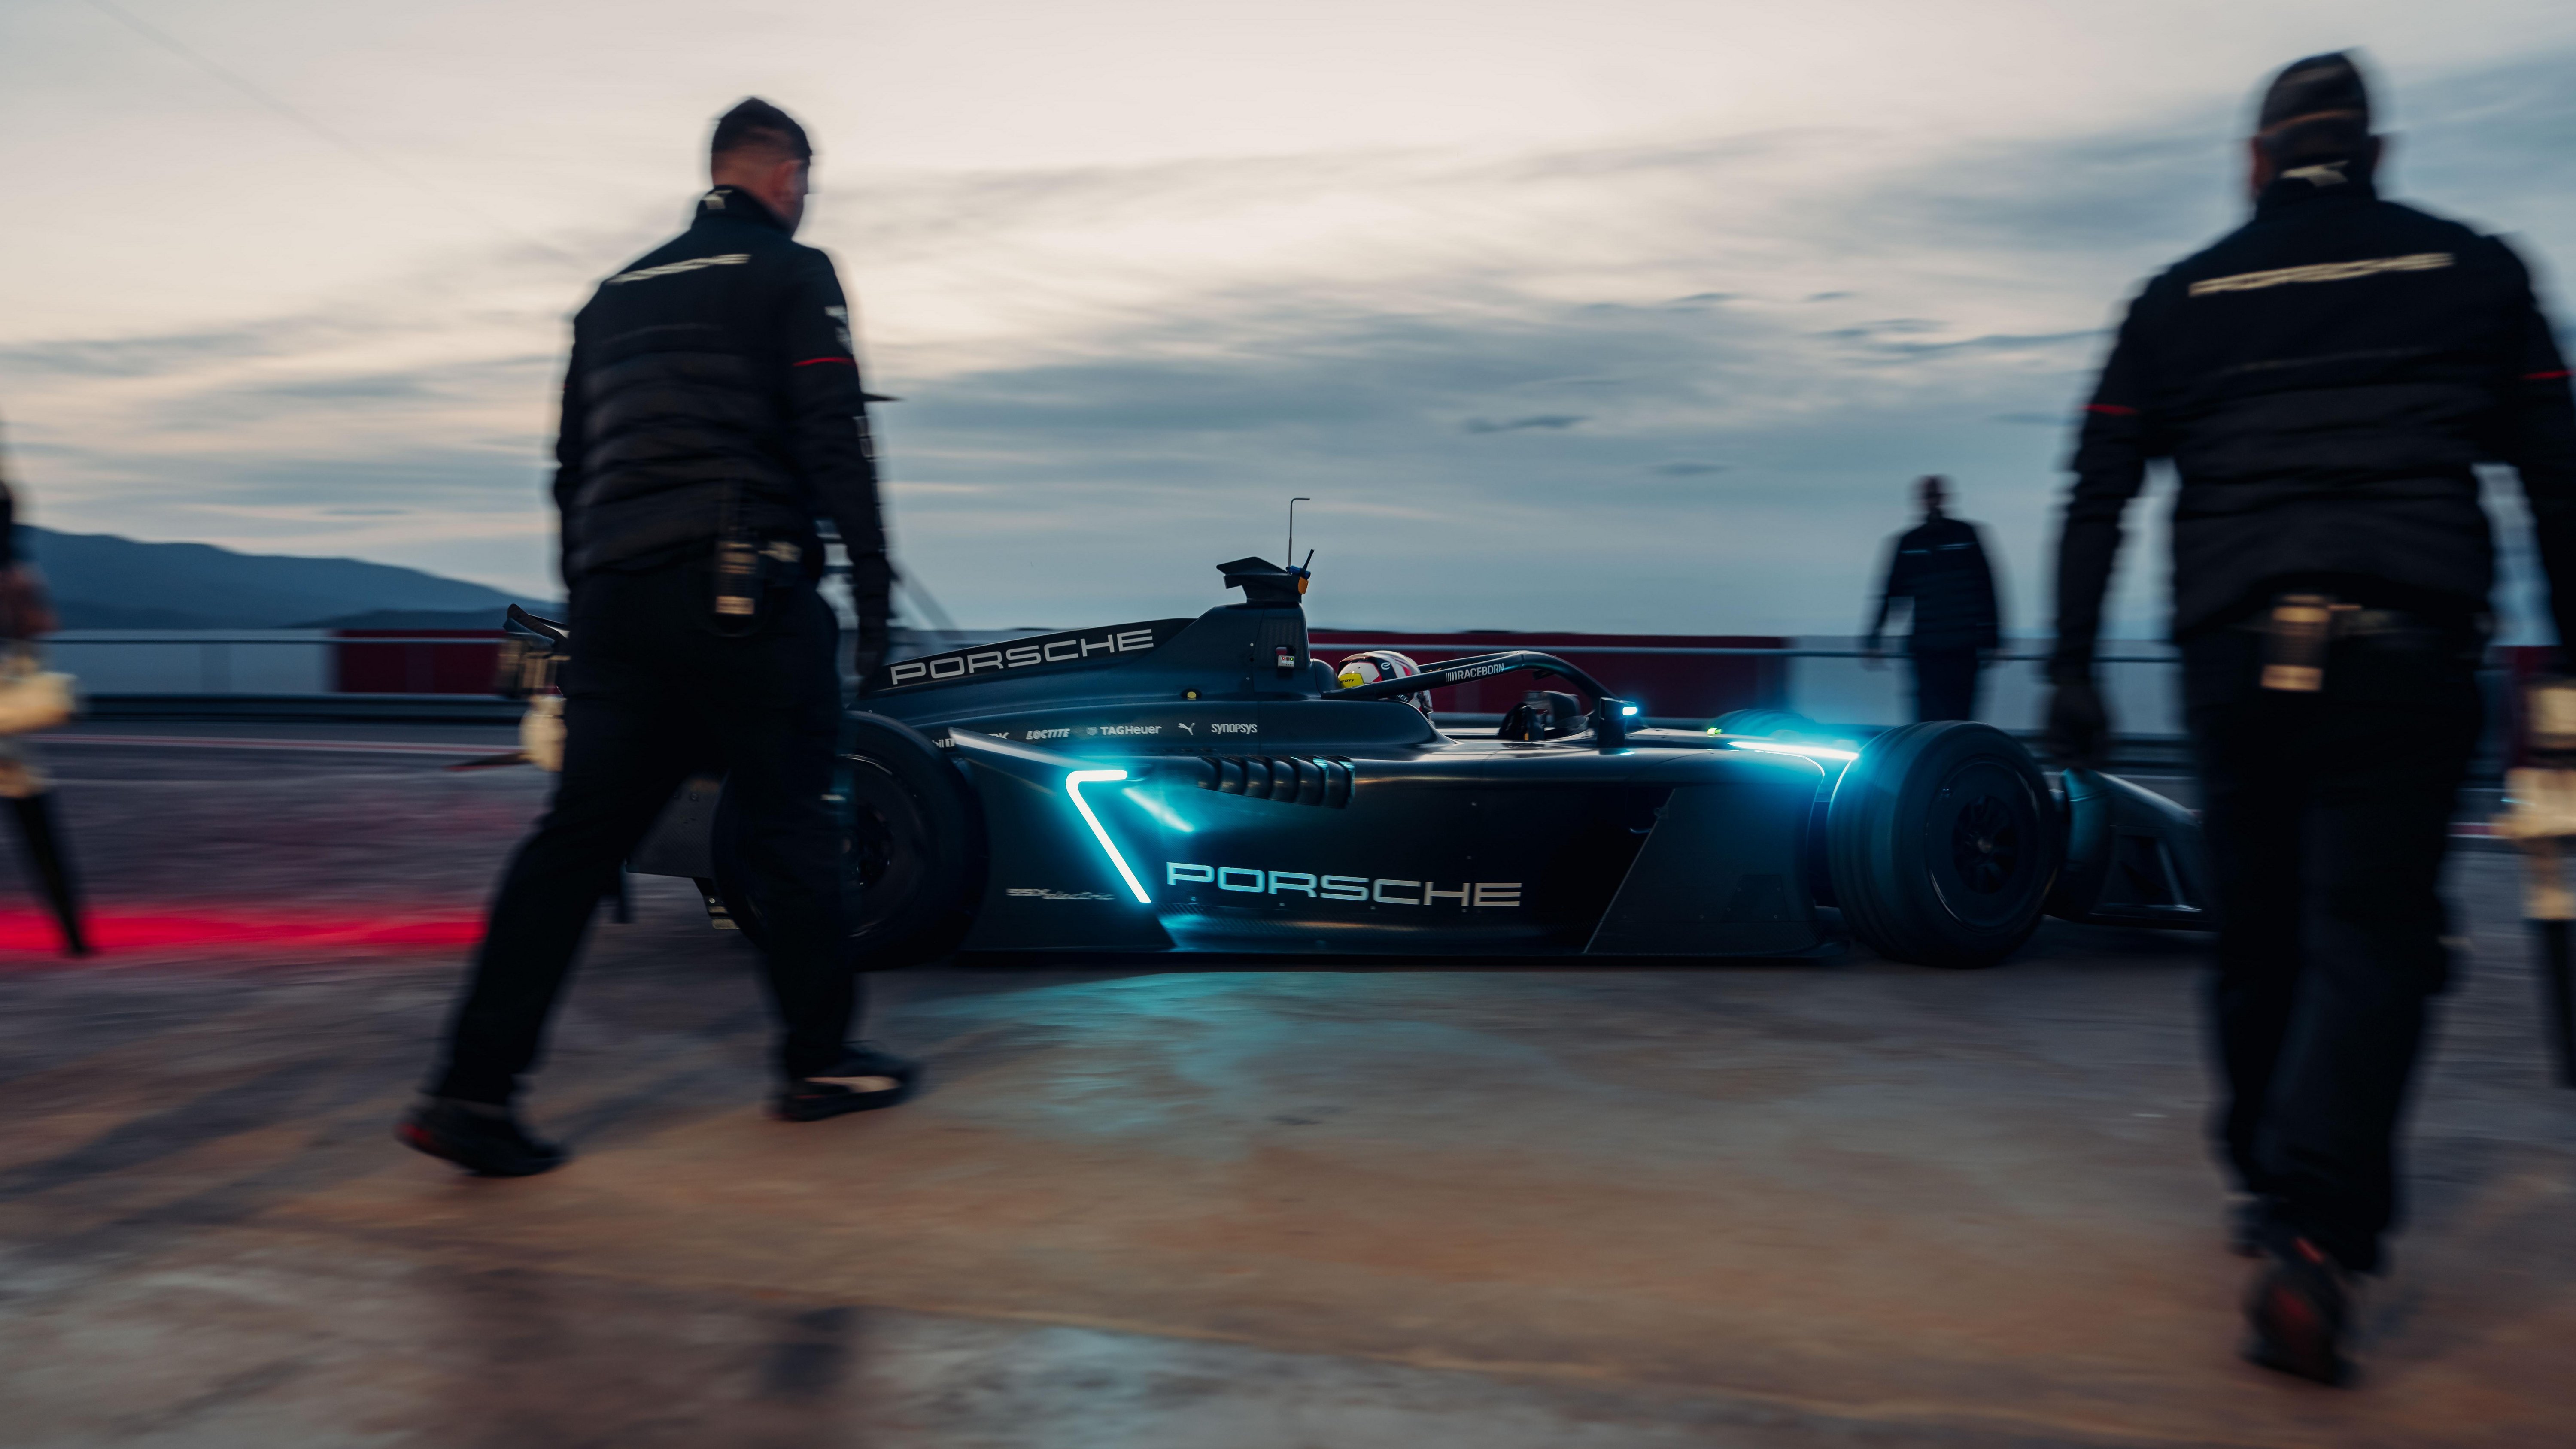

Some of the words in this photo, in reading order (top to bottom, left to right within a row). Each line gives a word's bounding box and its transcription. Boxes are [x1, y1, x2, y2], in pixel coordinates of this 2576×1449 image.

[890, 629, 1154, 685] PORSCHE
[1458, 663, 1504, 680] RACEBORN
[1026, 728, 1070, 740] LOCTITE
[1211, 724, 1258, 734] SYNOPSYS
[1166, 862, 1522, 906] PORSCHE
